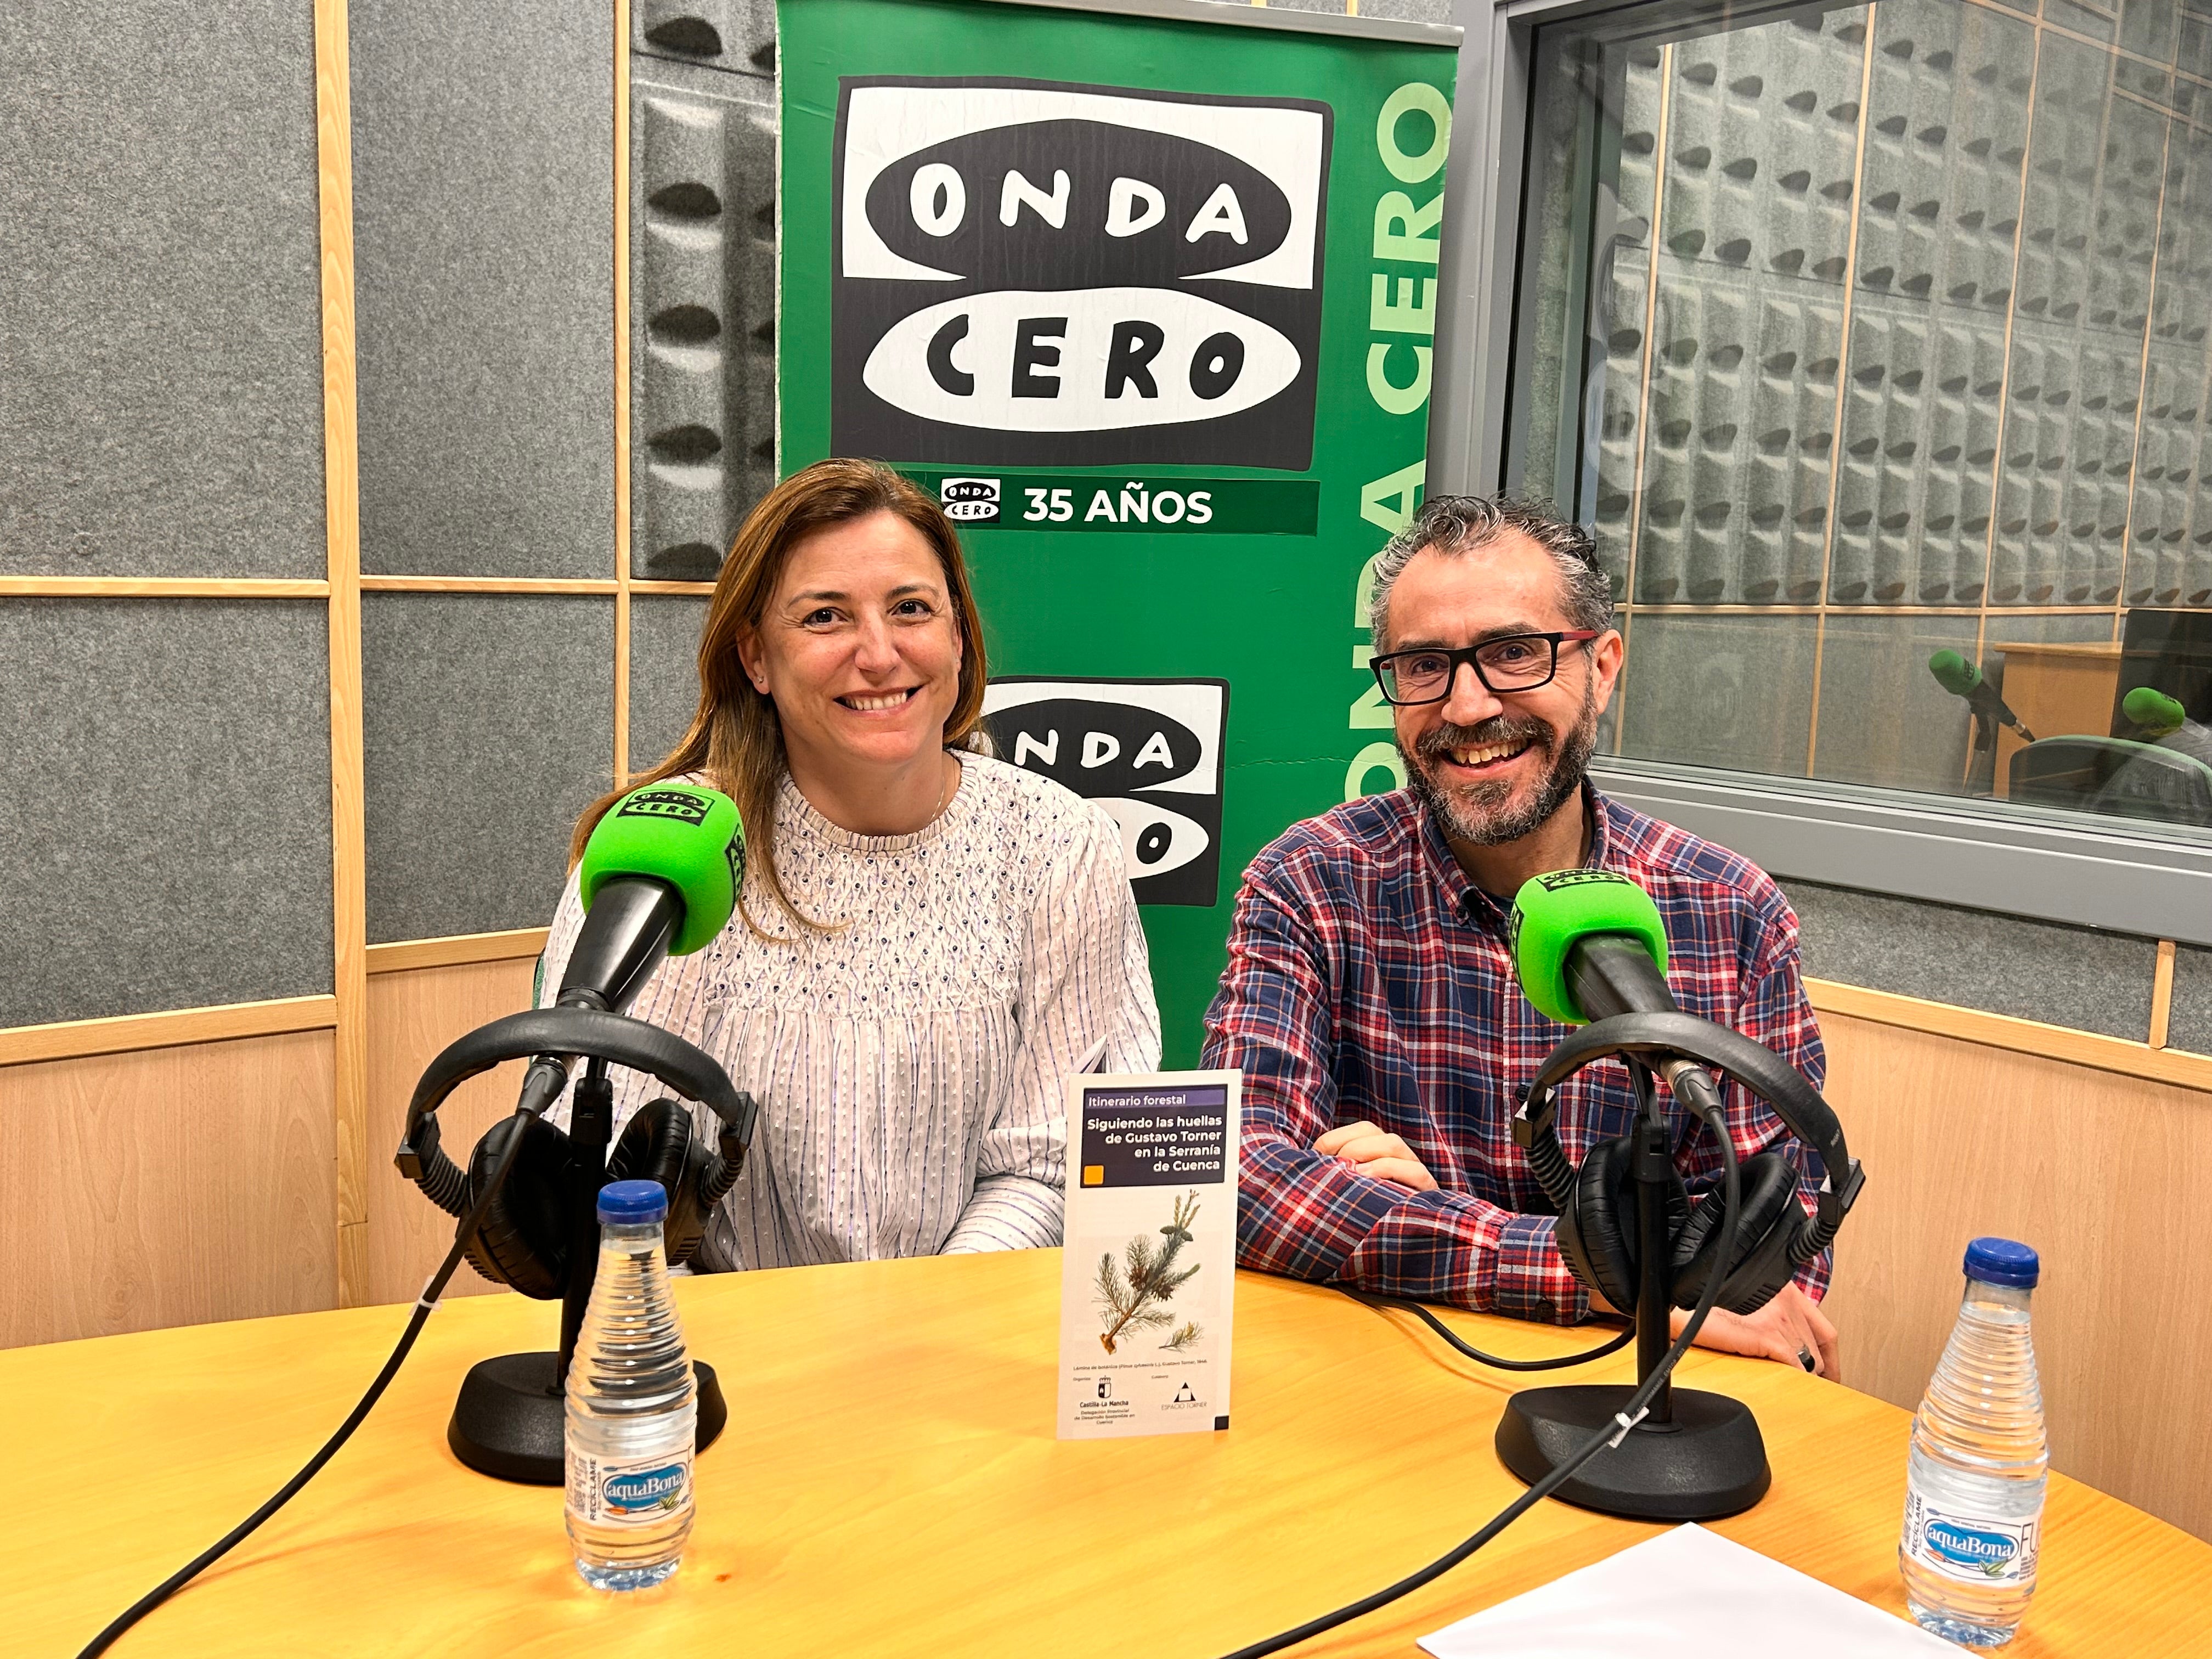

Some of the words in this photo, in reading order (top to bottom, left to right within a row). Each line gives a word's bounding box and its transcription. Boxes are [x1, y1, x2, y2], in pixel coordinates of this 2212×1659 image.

[910, 163, 1248, 245] ONDA
[1366, 82, 1453, 415] CERO
[927, 314, 1245, 400] CERO
[949, 486, 992, 497] ONDA
[1023, 488, 1074, 522] 35
[1084, 481, 1213, 524] AÑOS
[951, 505, 992, 516] CERO
[641, 794, 697, 804] ONDA
[636, 803, 692, 815] CERO
[1088, 1096, 1141, 1107] Itinerario
[1143, 1094, 1186, 1105] forestal
[1087, 1118, 1153, 1132] Siguiendo
[1156, 1117, 1173, 1127] las
[1177, 1115, 1222, 1127] huellas
[1105, 1134, 1122, 1144] de
[1125, 1132, 1177, 1144] Gustavo
[1181, 1131, 1222, 1142] Torner
[1135, 1149, 1150, 1158] en
[1154, 1146, 1165, 1157] la
[1169, 1144, 1221, 1156] Serranía
[1153, 1161, 1170, 1172] de
[1173, 1160, 1220, 1172] Cuenca
[608, 1471, 684, 1501] aquaBona
[1928, 1527, 2012, 1557] aquaBona
